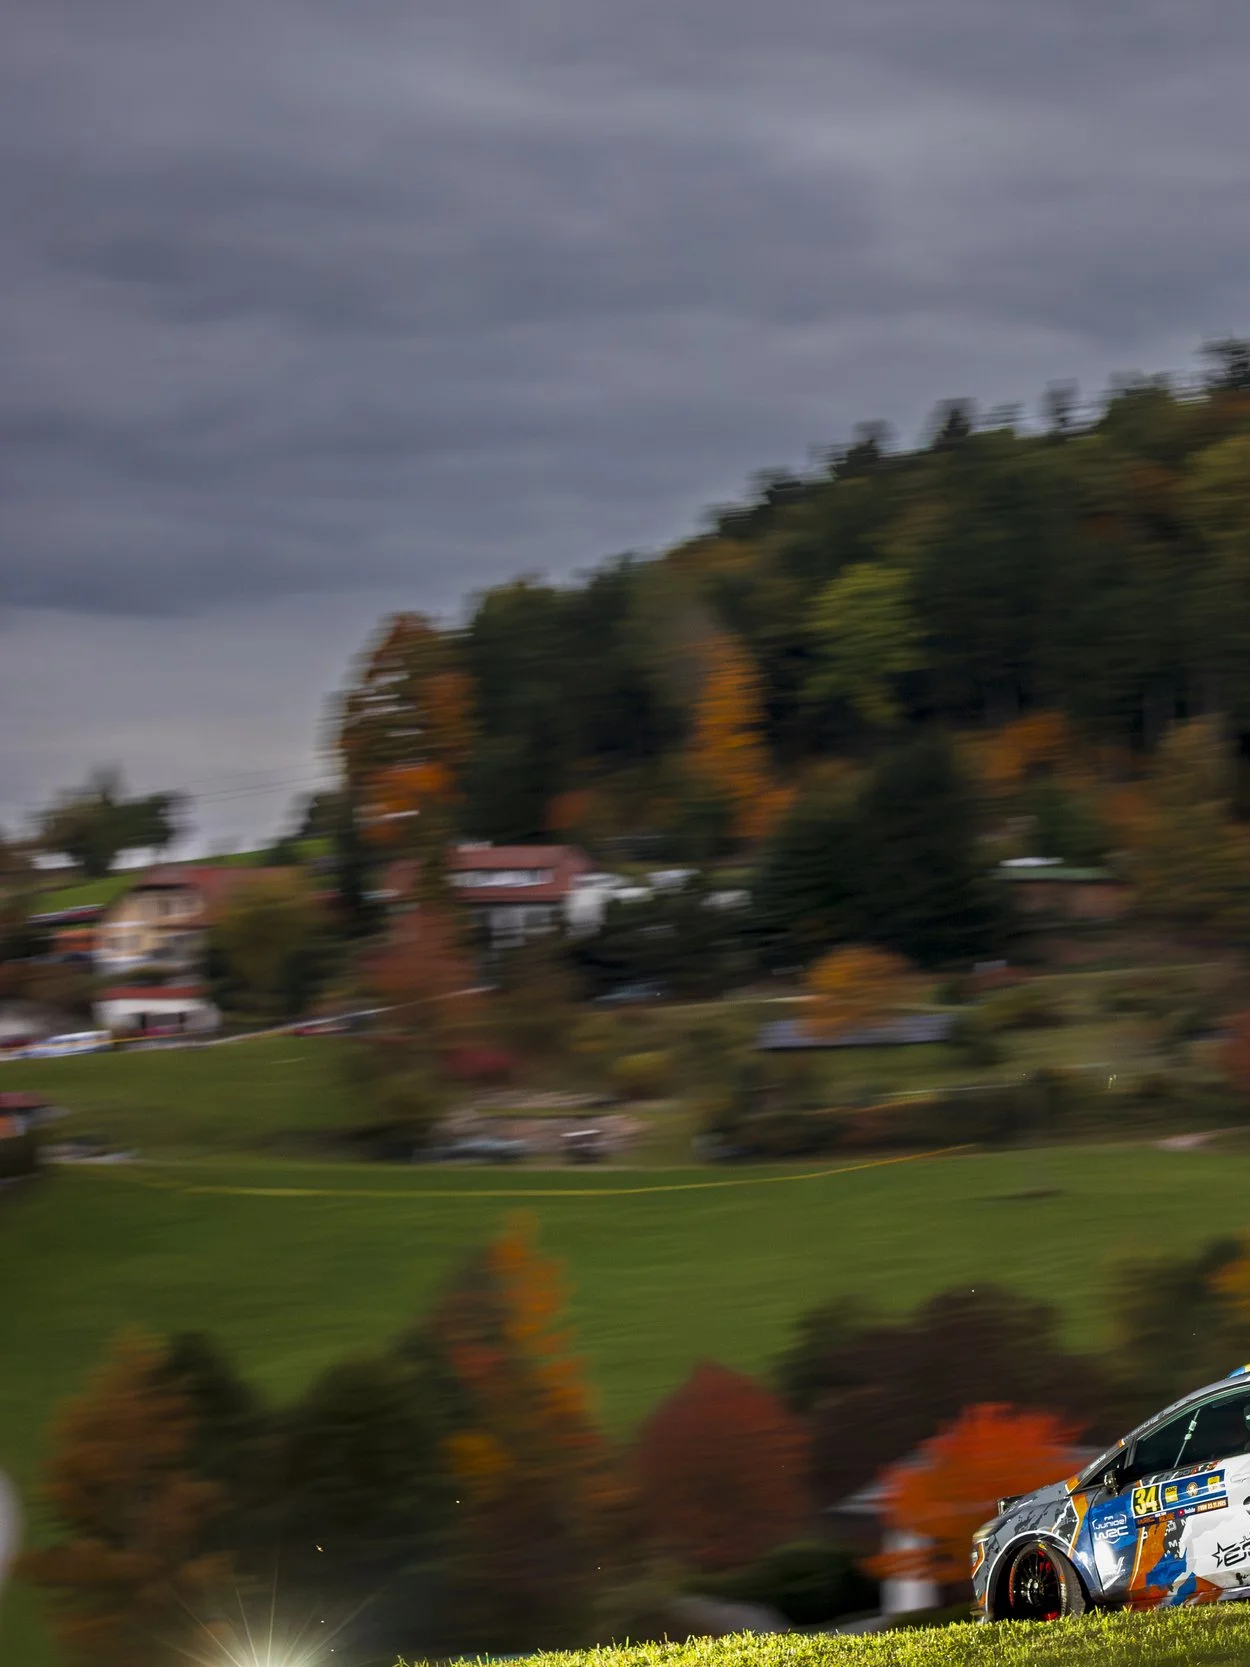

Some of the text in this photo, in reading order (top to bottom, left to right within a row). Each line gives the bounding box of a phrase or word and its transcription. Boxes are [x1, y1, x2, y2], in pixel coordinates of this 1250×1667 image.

[1135, 1485, 1159, 1516] 34
[1095, 1518, 1126, 1530] JUNIOR
[1094, 1526, 1129, 1540] WRC
